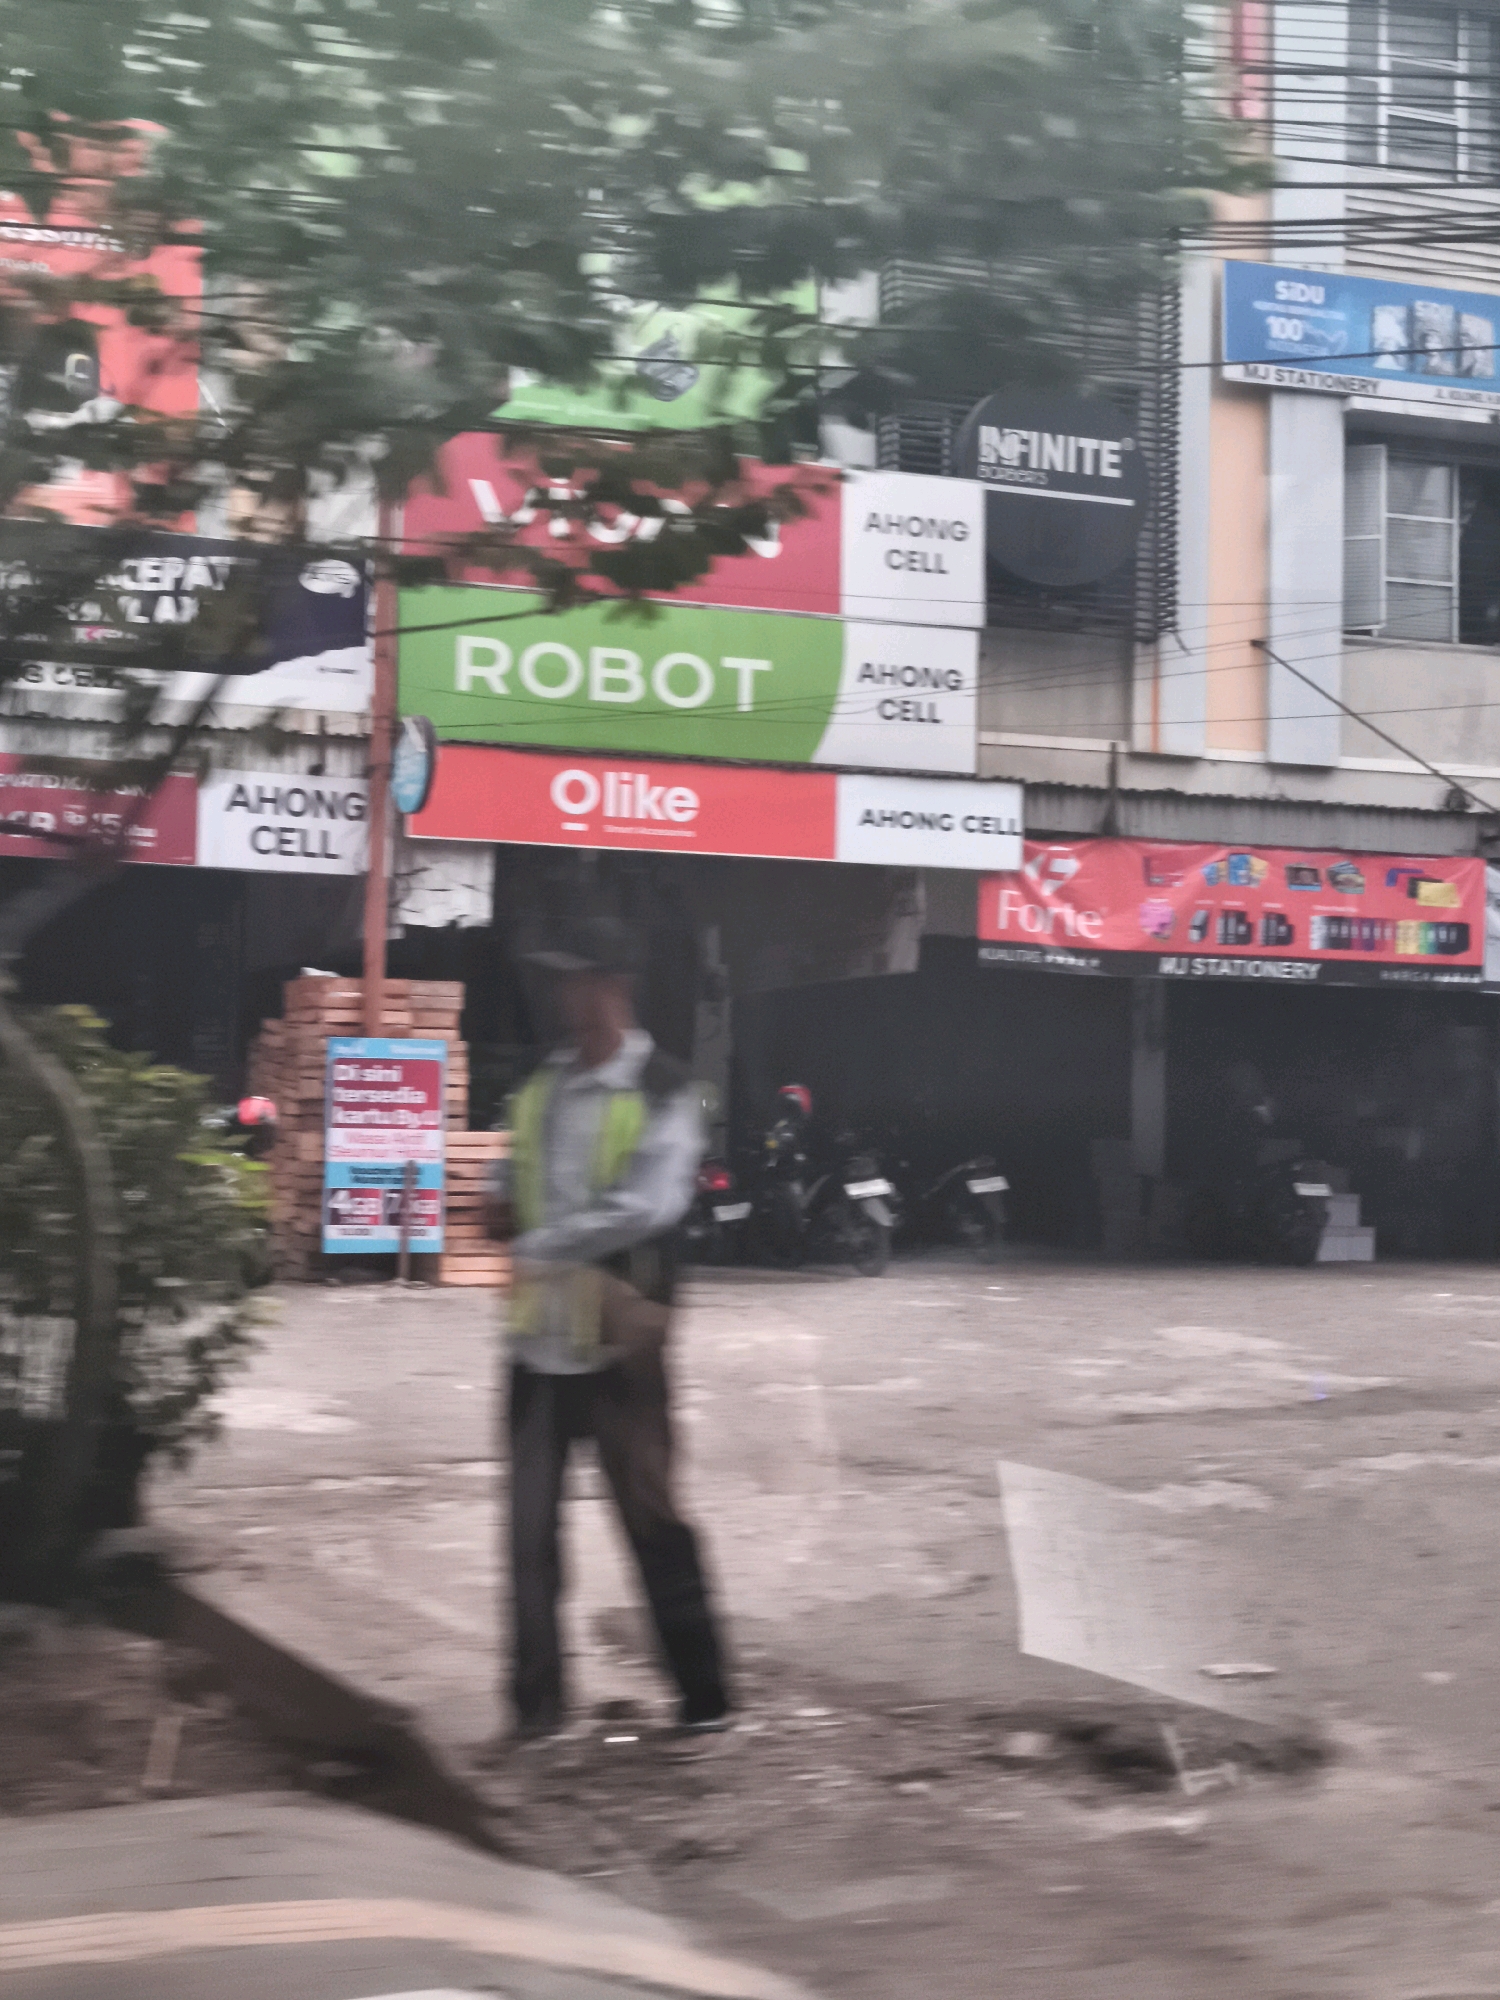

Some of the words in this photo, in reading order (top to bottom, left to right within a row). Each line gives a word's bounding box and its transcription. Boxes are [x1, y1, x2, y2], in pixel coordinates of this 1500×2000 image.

[1274, 368, 1381, 394] STATIONERY
[978, 425, 1122, 478] INFINITE
[863, 512, 970, 541] AHONG
[884, 548, 950, 575] CELL
[455, 635, 773, 712] ROBOT
[857, 662, 963, 691] AHONG
[877, 698, 942, 724] CELL
[224, 783, 368, 822] AHONG
[550, 769, 700, 823] Olike
[858, 809, 955, 832] AHONG
[961, 814, 1022, 836] CELL
[250, 825, 341, 860] CELL
[997, 889, 1104, 939] Forte
[1190, 958, 1322, 980] STATIONERY
